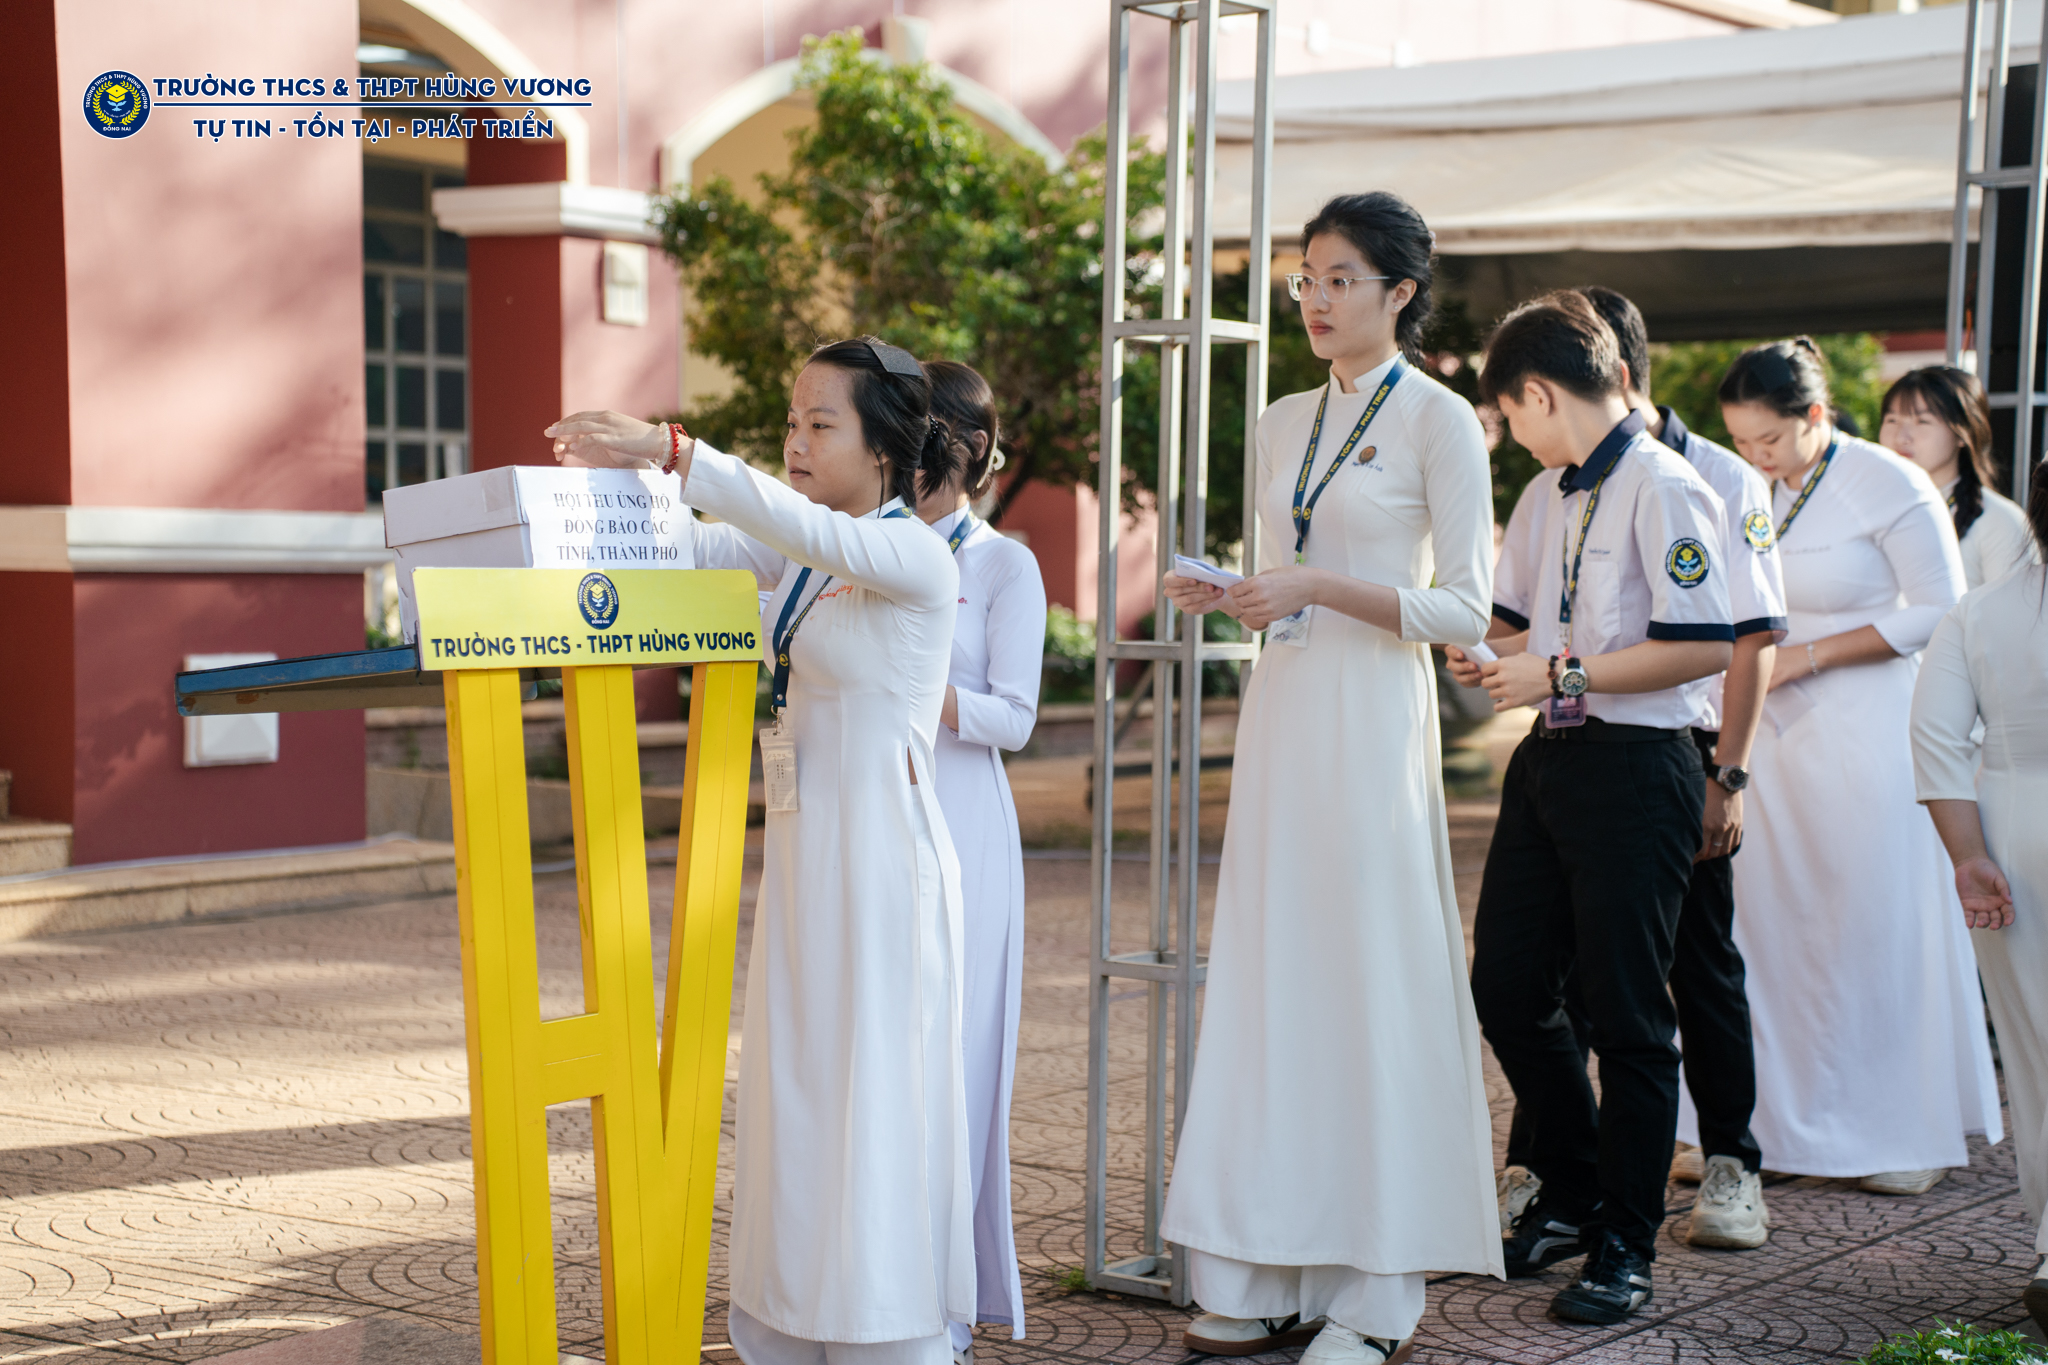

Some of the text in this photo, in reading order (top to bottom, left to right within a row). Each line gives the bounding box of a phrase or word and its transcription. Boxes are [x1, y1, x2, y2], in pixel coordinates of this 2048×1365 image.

[553, 491, 582, 511] HỘI
[650, 493, 670, 512] HỘ
[608, 516, 638, 534] BÀO
[641, 516, 669, 534] CÁC
[596, 542, 648, 560] THÀNH
[651, 542, 678, 560] PHỐ
[431, 632, 516, 658] TRƯỜNG
[520, 636, 570, 654] THCS
[586, 634, 633, 654] THPT
[640, 628, 690, 652] HÙNG
[694, 632, 756, 650] VƯƠNG
